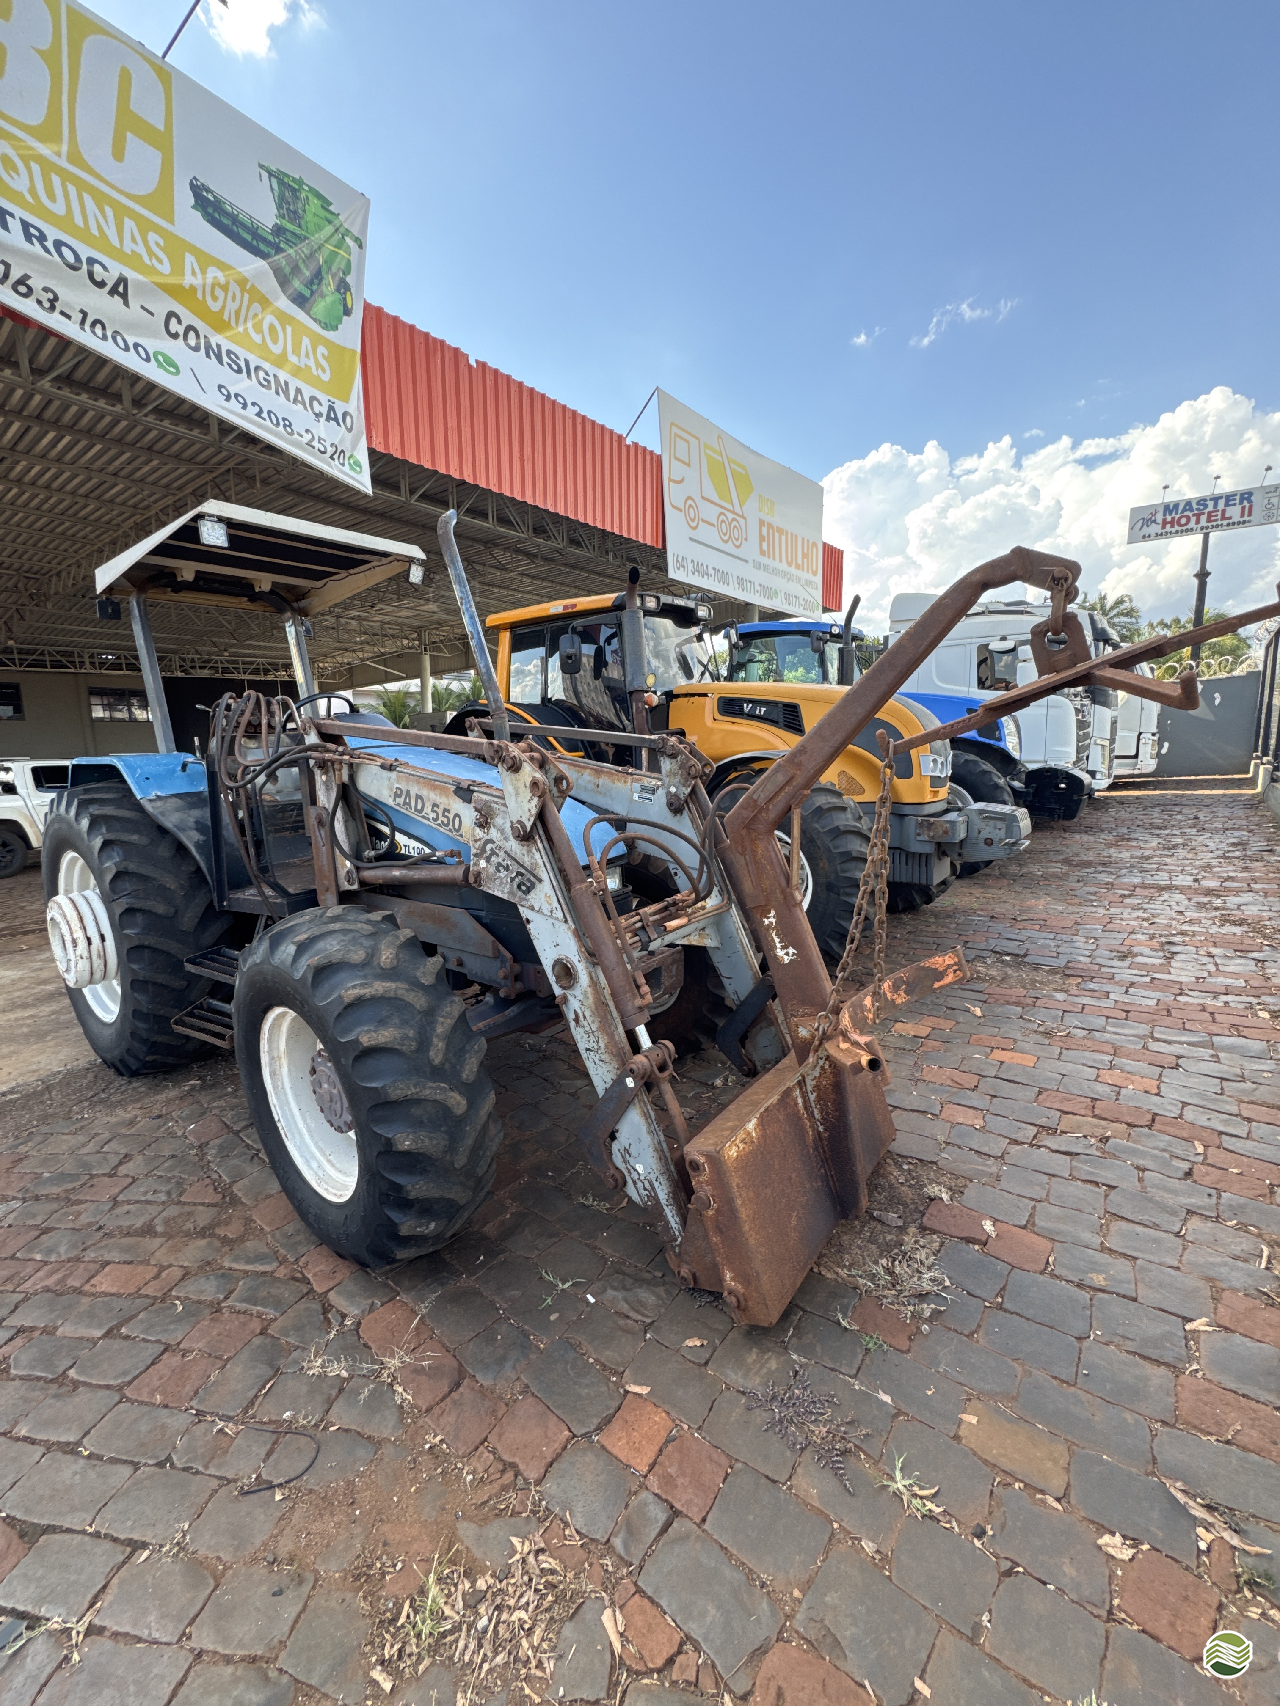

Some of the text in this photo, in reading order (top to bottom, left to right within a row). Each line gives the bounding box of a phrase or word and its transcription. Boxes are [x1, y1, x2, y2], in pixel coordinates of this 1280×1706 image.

[0, 205, 131, 309] TROCA
[163, 310, 354, 434] CONSIGNAÇÃO
[182, 251, 331, 382] AGRÍCOLAS
[217, 383, 346, 467] 99208-2520
[1161, 508, 1232, 530] HOTEL
[1239, 504, 1253, 519] II
[1162, 491, 1254, 518] MASTER
[672, 552, 689, 578] (64)
[690, 558, 730, 587] 3404-7000
[736, 575, 774, 601] 98171-7000
[758, 517, 819, 577] ENTULHO
